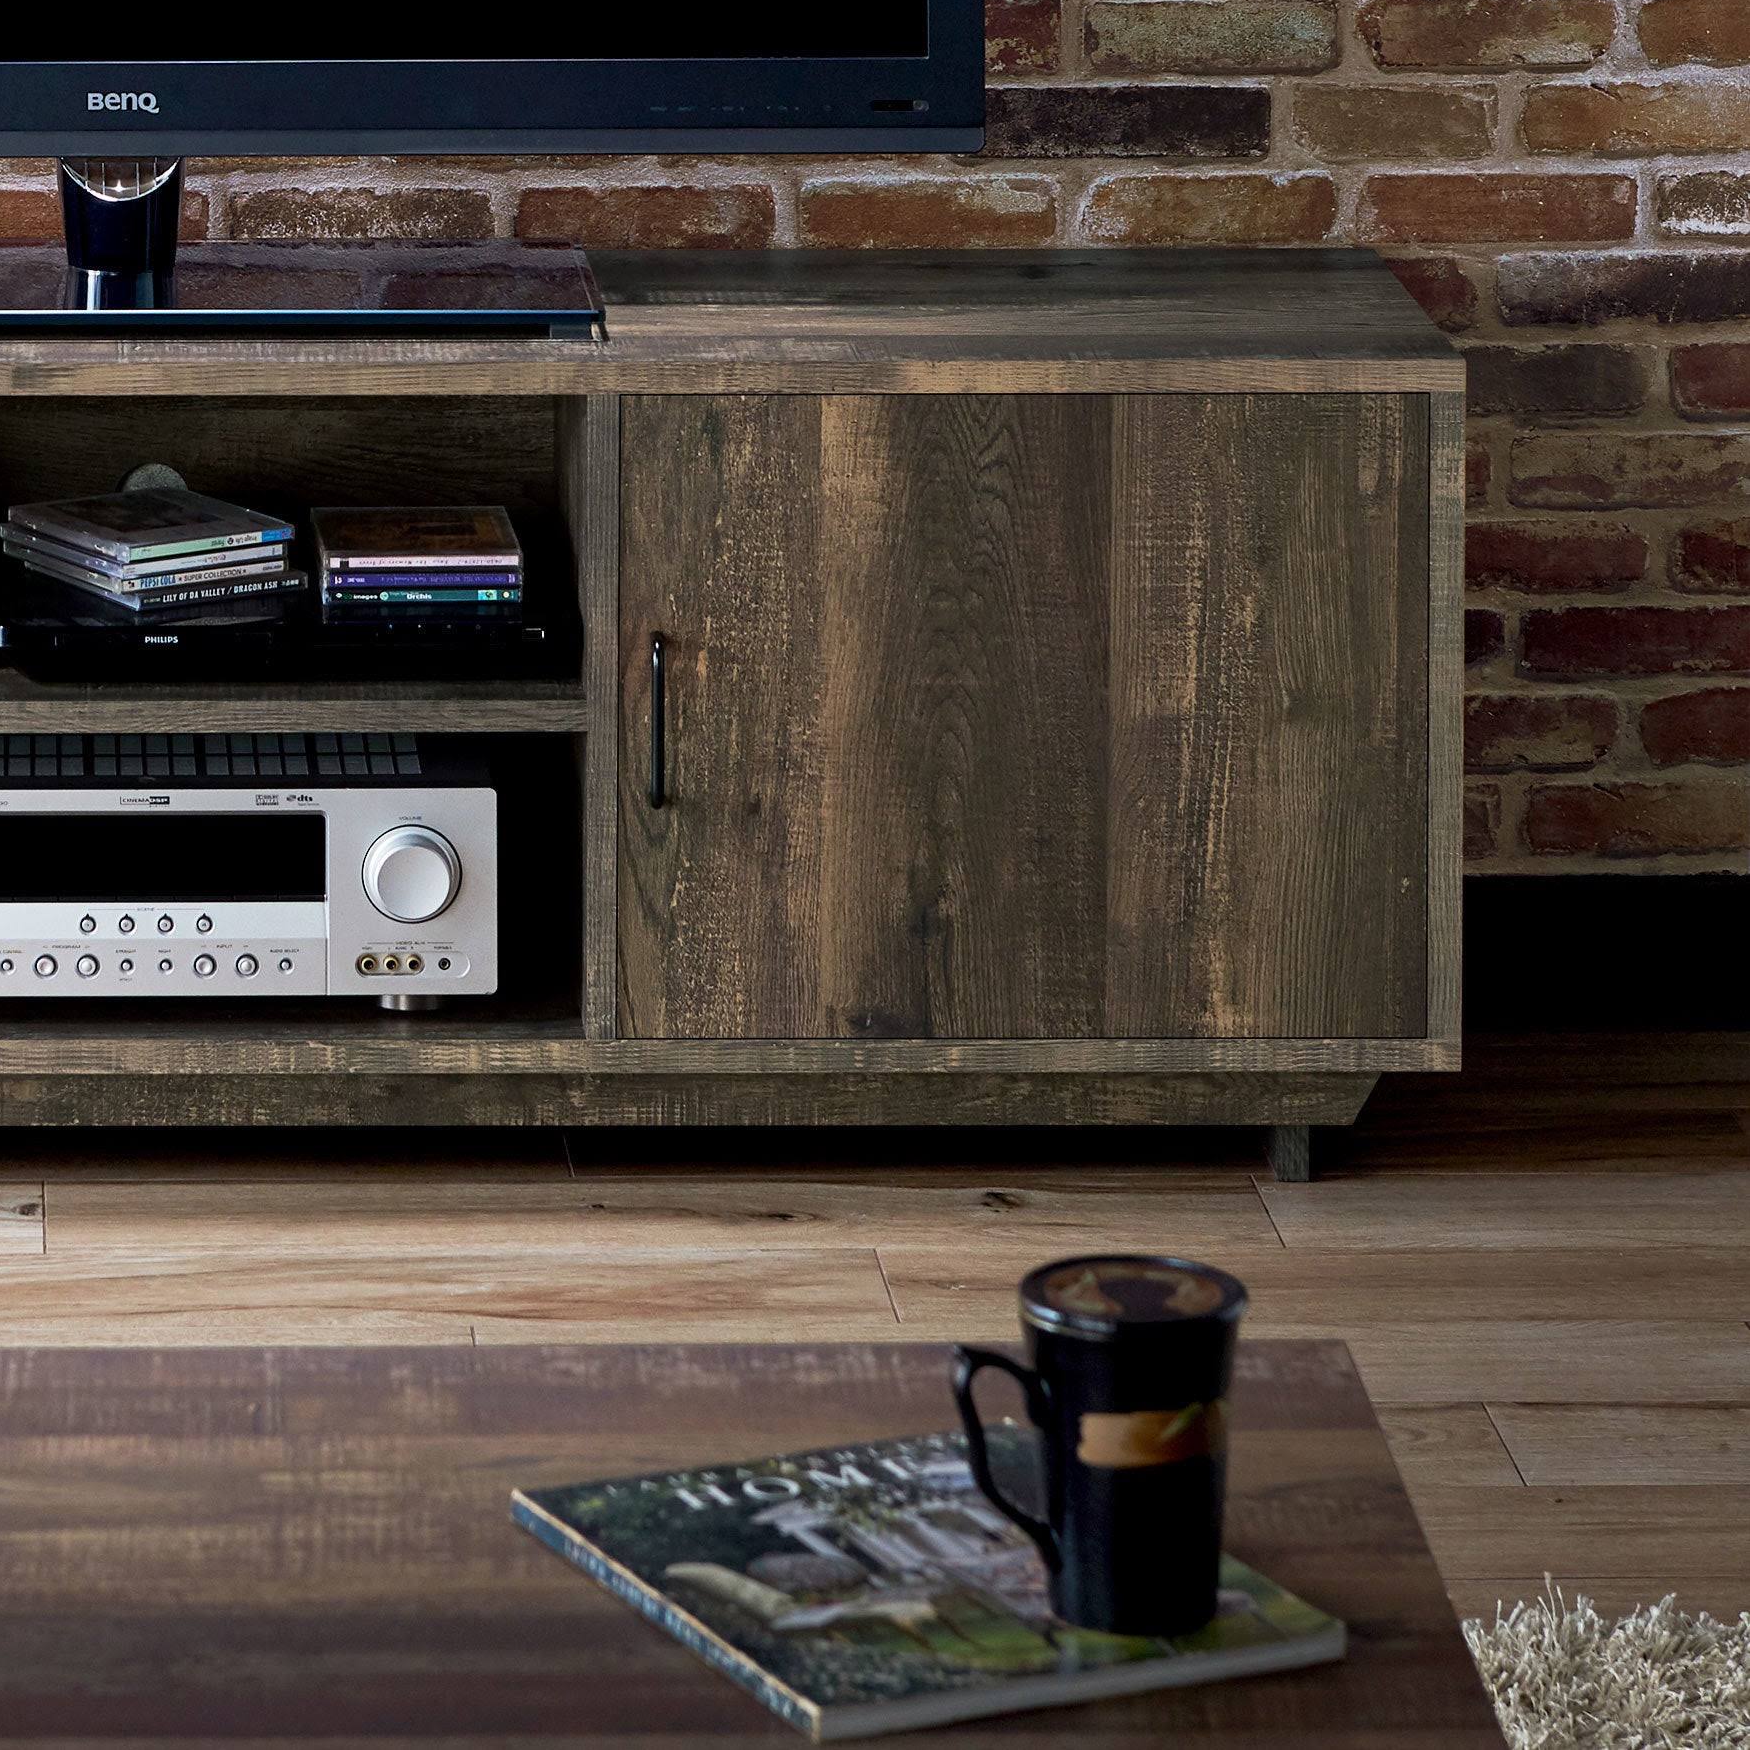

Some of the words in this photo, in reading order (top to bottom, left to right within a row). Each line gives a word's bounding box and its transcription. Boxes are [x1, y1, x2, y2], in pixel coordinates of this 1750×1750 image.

[87, 92, 160, 114] BenQ
[140, 577, 159, 588] PEPSI
[159, 575, 176, 585] COLA
[203, 568, 242, 579] COLLECTION
[162, 593, 178, 603] LILY
[179, 592, 188, 601] OF
[189, 591, 199, 599] DA
[201, 588, 226, 598] VALLEY
[233, 583, 262, 593] DRAGON
[263, 580, 278, 589] ASH
[297, 794, 313, 802] dts
